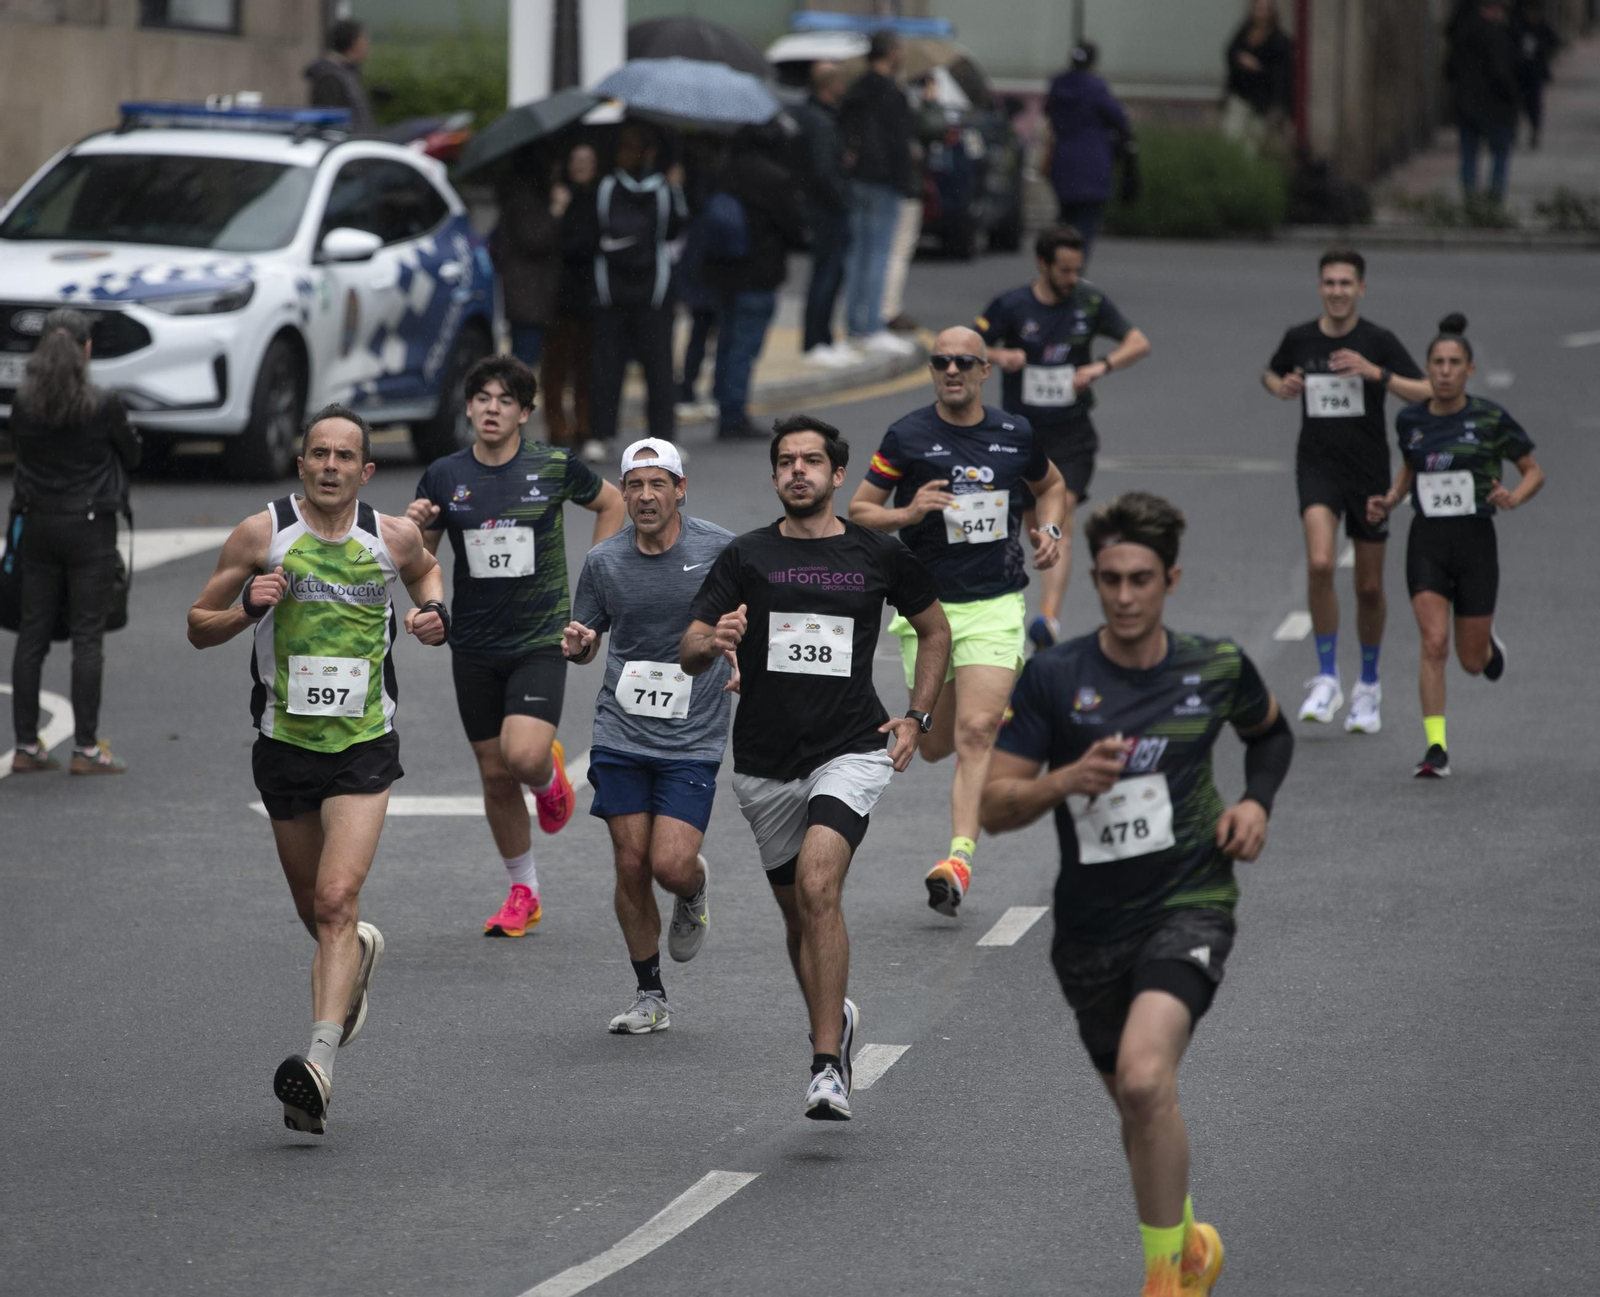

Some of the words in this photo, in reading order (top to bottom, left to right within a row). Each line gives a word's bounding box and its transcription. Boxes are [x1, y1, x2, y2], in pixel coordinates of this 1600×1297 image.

[1320, 395, 1351, 410] 794
[951, 465, 994, 483] 200
[1432, 494, 1462, 508] 243
[962, 517, 996, 535] 547
[488, 554, 512, 569] 87
[788, 568, 865, 585] Fonseca
[822, 584, 866, 592] OPOSICIONES
[788, 644, 832, 663] 338
[306, 687, 350, 705] 597
[633, 688, 673, 707] 717
[1099, 818, 1150, 847] 478
